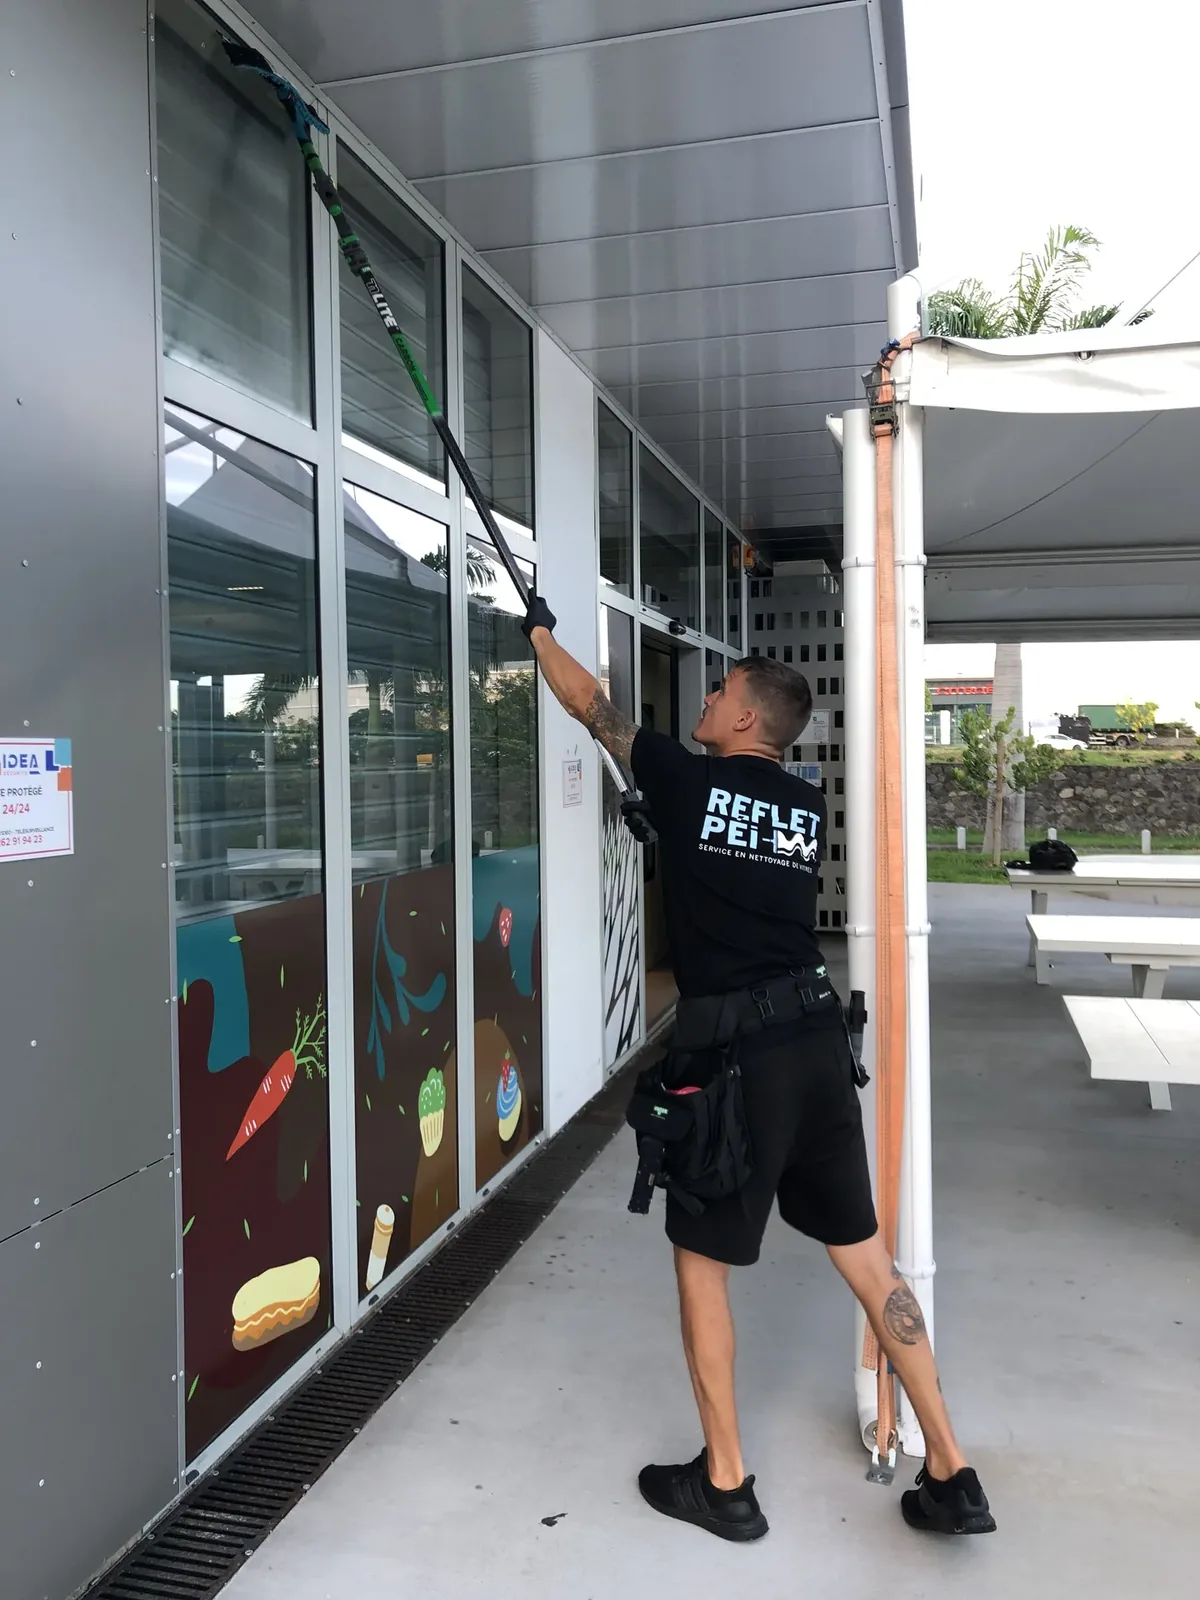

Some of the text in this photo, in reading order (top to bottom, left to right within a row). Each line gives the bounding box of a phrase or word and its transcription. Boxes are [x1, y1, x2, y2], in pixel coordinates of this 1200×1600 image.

[7, 785, 42, 796] PROTÉGÉ
[2, 803, 30, 814] 24/24
[706, 787, 821, 838] REFLET
[12, 836, 21, 846] 91
[22, 835, 32, 845] 94
[33, 834, 43, 844] 23
[698, 843, 732, 856] SERVICE
[734, 850, 746, 859] EN
[748, 853, 791, 868] NETTOYAGE
